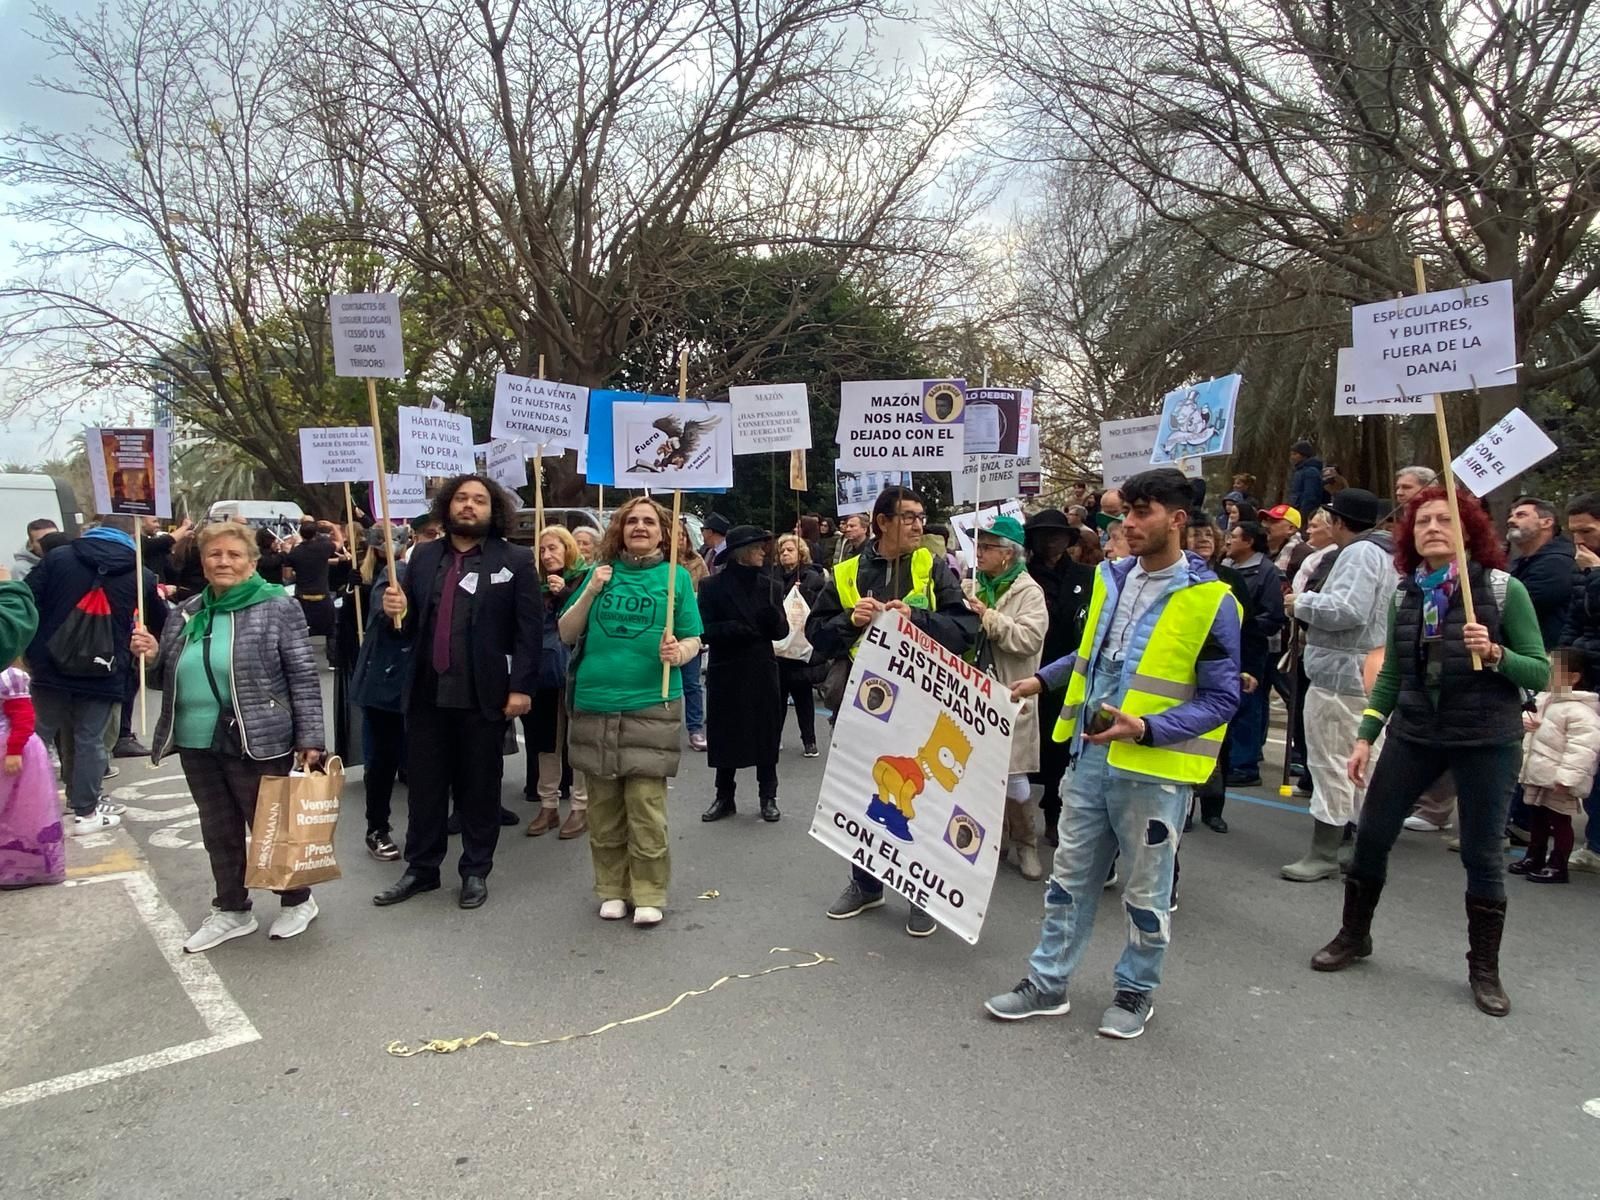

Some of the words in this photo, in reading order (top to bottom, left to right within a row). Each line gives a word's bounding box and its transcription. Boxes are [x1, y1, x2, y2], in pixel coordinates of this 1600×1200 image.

[378, 302, 386, 310] DE
[1372, 295, 1489, 323] ESPECULADORES
[1390, 328, 1399, 339] Y
[1403, 318, 1472, 338] BUITRES,
[353, 344, 376, 353] GRANS
[1383, 343, 1432, 360] FUERA
[1437, 339, 1456, 352] DE
[1462, 336, 1481, 348] LA
[508, 382, 523, 392] NO
[525, 385, 532, 393] A
[534, 387, 545, 395] LA
[547, 389, 576, 400] VENTA
[965, 392, 978, 400] LO
[980, 391, 1015, 400] DEBEN
[511, 396, 522, 404] DE
[525, 398, 572, 412] NUESTRAS
[871, 393, 920, 407] MAZÓN
[512, 409, 560, 423] VIVIENDAS
[757, 410, 786, 419] PENSADO
[864, 413, 891, 423] NOS
[896, 412, 923, 423] HAS
[411, 416, 461, 431] HABITATGES
[506, 420, 571, 438] EXTRANJEROS!
[411, 430, 428, 440] PER
[430, 433, 437, 441] A
[750, 428, 777, 436] JUERGA
[850, 430, 901, 440] DEJADO
[905, 429, 934, 439] CON
[938, 429, 954, 439] EL
[634, 432, 660, 454] Fuera
[421, 446, 435, 455] NO
[437, 448, 451, 458] PER
[452, 450, 458, 458] A
[853, 446, 888, 457] CULO
[891, 446, 909, 457] AL
[912, 446, 944, 457] AIRE
[1111, 451, 1138, 460] FALTAN
[1475, 442, 1495, 462] CON
[1492, 460, 1506, 475] EL
[416, 460, 463, 472] ESPECULAR!
[1004, 459, 1014, 468] ES
[1016, 456, 1032, 467] QUE
[1464, 457, 1488, 478] AIRE
[601, 593, 653, 613] STOP
[866, 625, 891, 650] EL
[898, 640, 970, 705] SISTEMA
[975, 699, 1011, 737] NOS
[888, 655, 916, 686] HA
[920, 678, 986, 736] DEJADO
[258, 802, 281, 869] ROSSMANN
[833, 811, 873, 849] CON
[878, 840, 902, 868] EL
[909, 860, 965, 909] CULO
[852, 847, 876, 874] AL
[881, 862, 929, 909] AIRE
